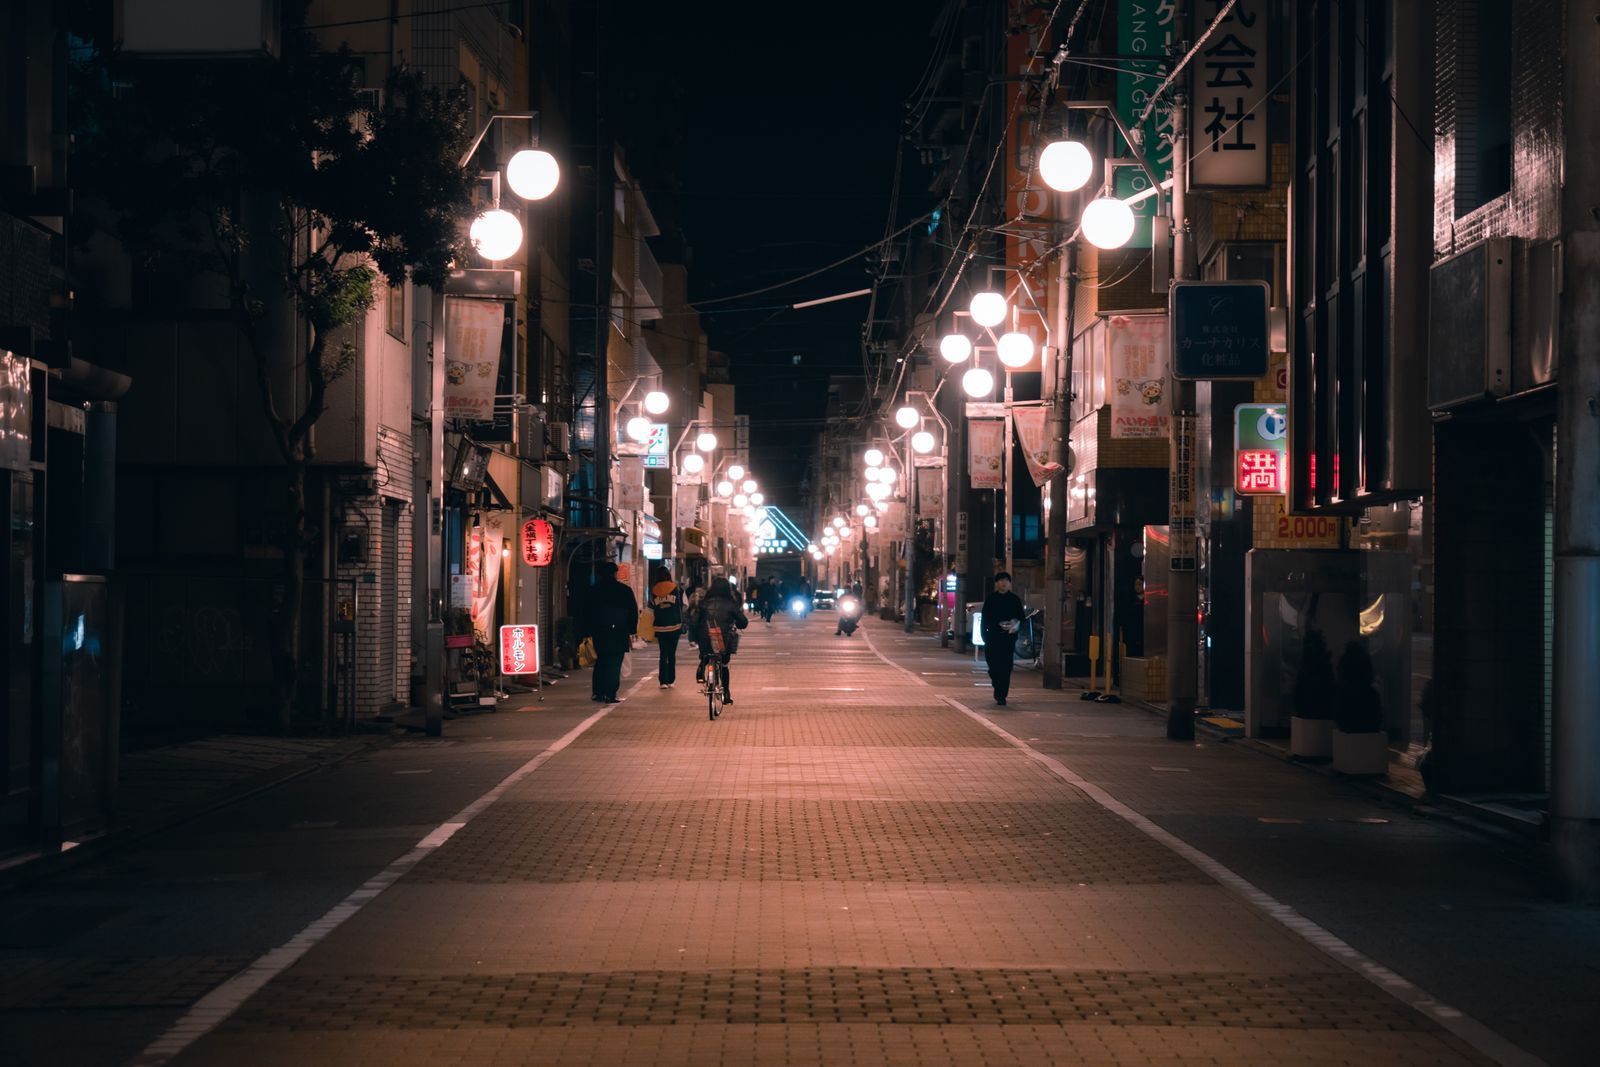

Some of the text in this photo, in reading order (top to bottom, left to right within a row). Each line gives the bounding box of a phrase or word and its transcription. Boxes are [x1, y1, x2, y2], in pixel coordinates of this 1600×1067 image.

[1201, 352, 1241, 368] 化粧品
[1116, 416, 1167, 427] へいわ通り
[1242, 452, 1277, 489] 満
[1279, 517, 1336, 538] 2,000円
[512, 628, 526, 672] ホルモン
